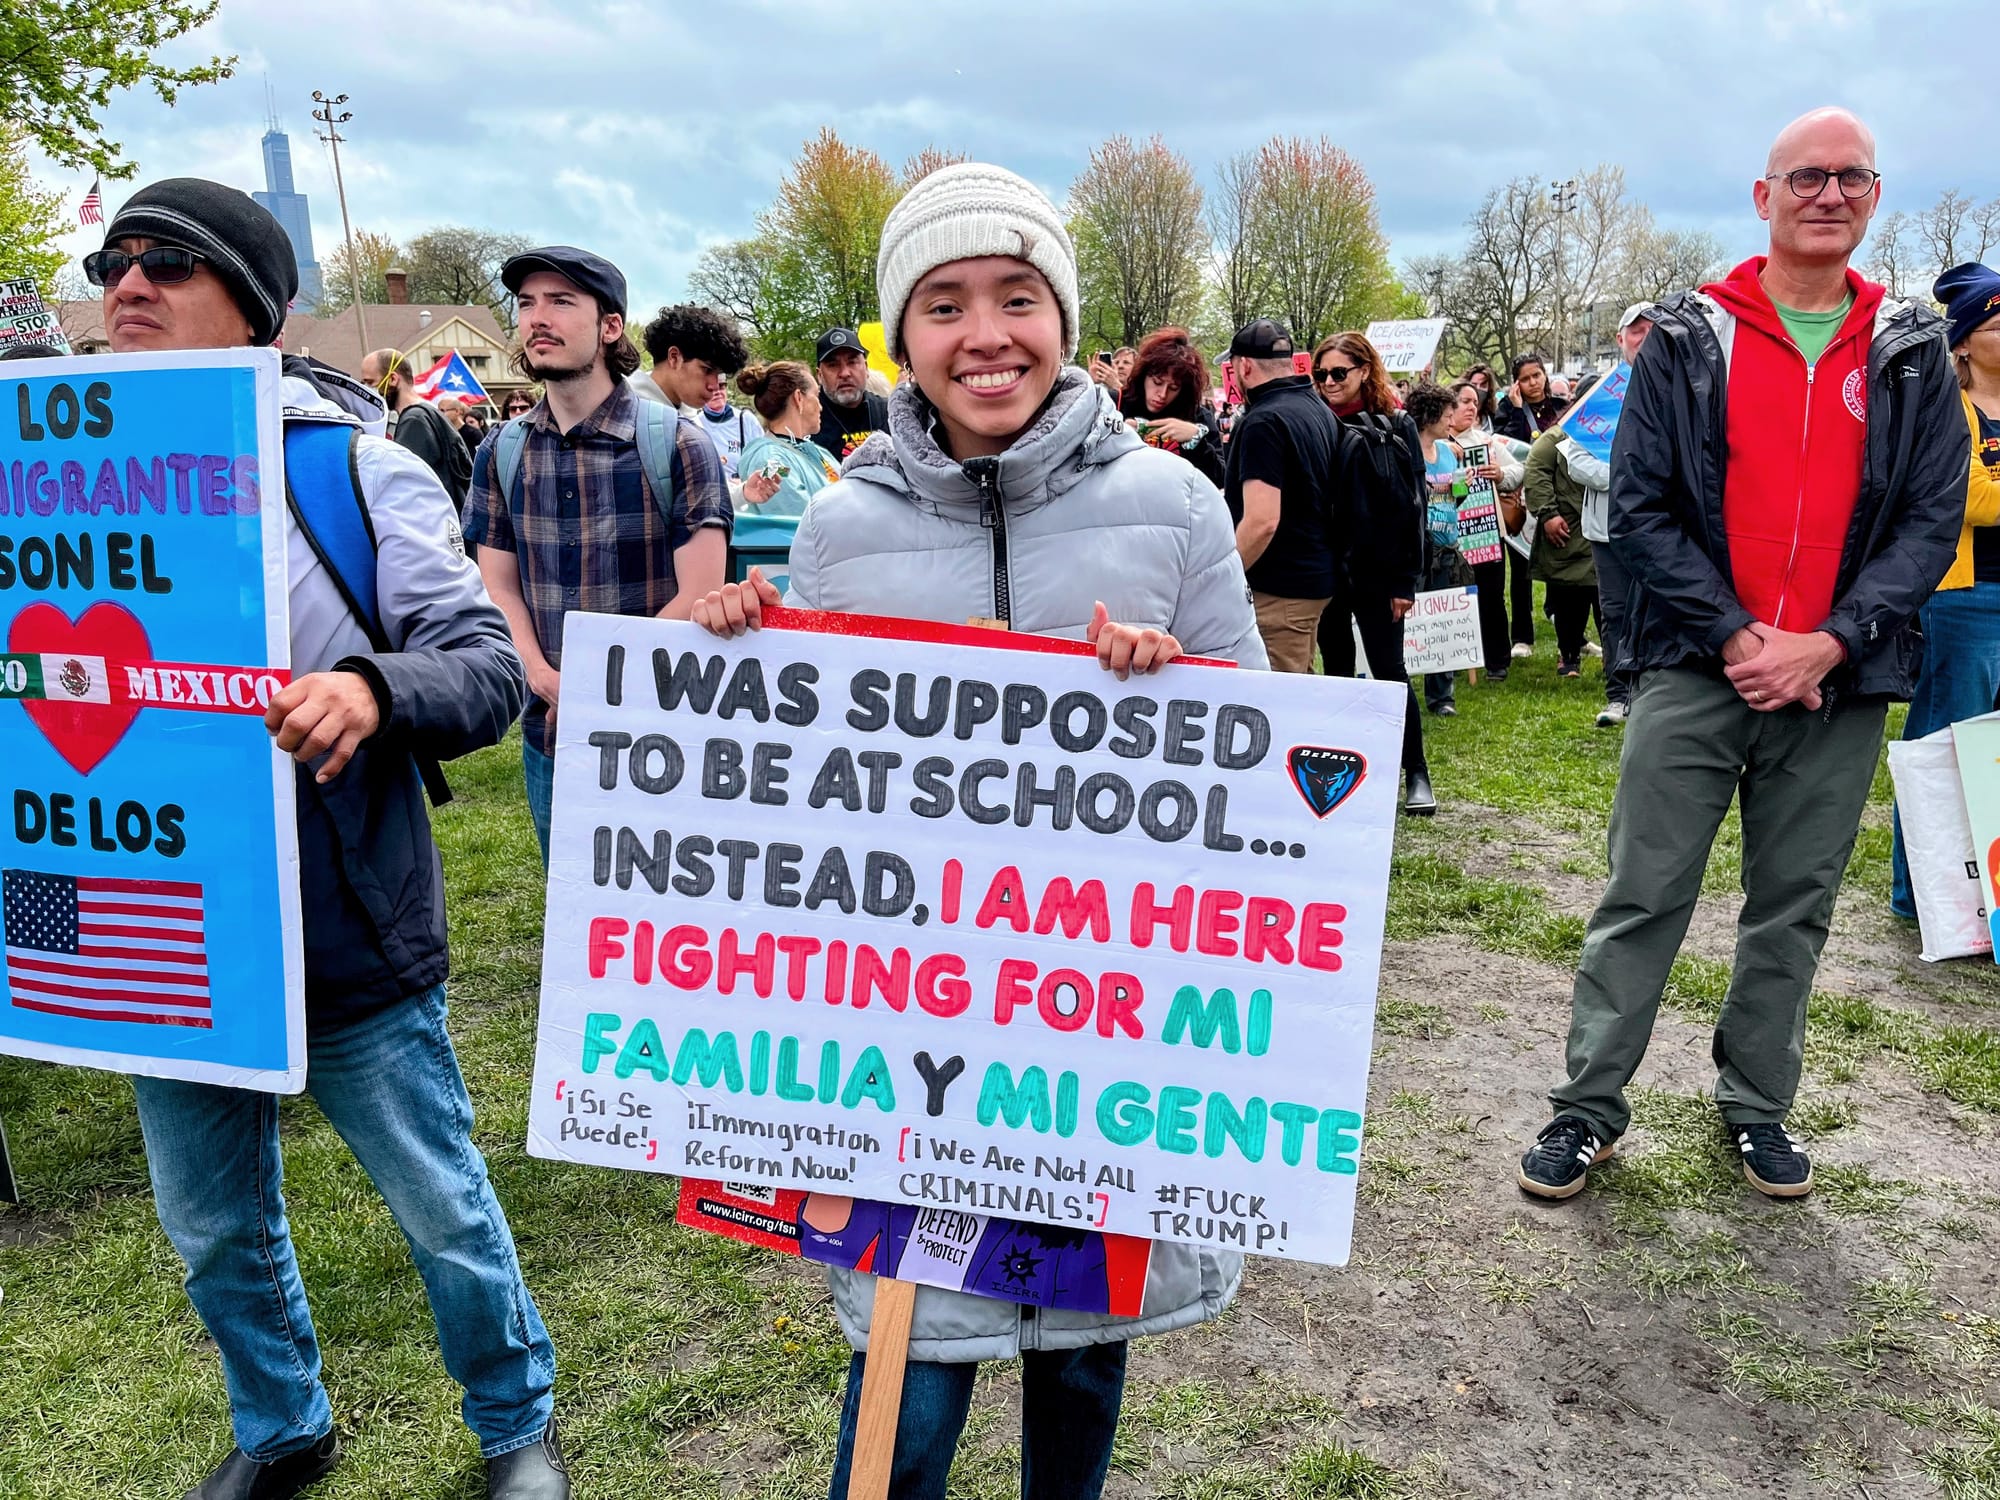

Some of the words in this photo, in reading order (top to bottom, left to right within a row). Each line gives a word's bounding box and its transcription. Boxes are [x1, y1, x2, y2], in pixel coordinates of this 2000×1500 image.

[6, 281, 35, 296] THE
[15, 314, 51, 334] STOP
[20, 328, 48, 342] TRUMP
[1396, 352, 1416, 368] UP
[17, 382, 114, 442] LOS
[1462, 447, 1486, 468] HE
[1465, 505, 1495, 519] CRIMES
[1480, 515, 1496, 525] AND
[1470, 523, 1497, 536] RIGHTS
[0, 531, 95, 592] SON
[106, 531, 174, 595] EL
[1463, 547, 1491, 560] CATION
[1424, 593, 1470, 616] STAND
[1454, 629, 1475, 642] How
[1407, 650, 1445, 668] Republi
[123, 665, 283, 711] MEXICO
[606, 645, 626, 706] I
[652, 648, 820, 728] WAS
[845, 668, 1272, 770] SUPPOSED
[588, 731, 686, 795] TO
[701, 738, 793, 806] BE
[807, 747, 903, 813] AT
[13, 789, 78, 846] DE
[89, 796, 187, 858] LOS
[593, 825, 930, 927] INSTEAD,
[941, 858, 964, 925] I
[975, 865, 1112, 943] AM
[1130, 881, 1348, 973] HERE
[587, 916, 973, 1019] FIGHTING
[993, 958, 1145, 1041] FOR
[1161, 984, 1273, 1056] MI
[581, 1011, 897, 1113] FAMILIA
[912, 1050, 966, 1117] Y
[976, 1061, 1080, 1139] MI
[1095, 1080, 1363, 1176] GENTE
[616, 1091, 653, 1119] Se
[685, 1140, 783, 1177] Reform
[791, 1155, 857, 1183] Now!
[982, 1145, 1026, 1174] Are
[1034, 1156, 1087, 1184] Not
[1094, 1165, 1137, 1193] All
[1155, 1184, 1268, 1220] #FUCK
[702, 1201, 797, 1236] www.icirr.org/fsn
[917, 1206, 979, 1246] DEFEND
[1148, 1210, 1288, 1253] TRUMP!
[923, 1239, 968, 1267] PROTECT
[991, 1281, 1041, 1300] ICIRR
